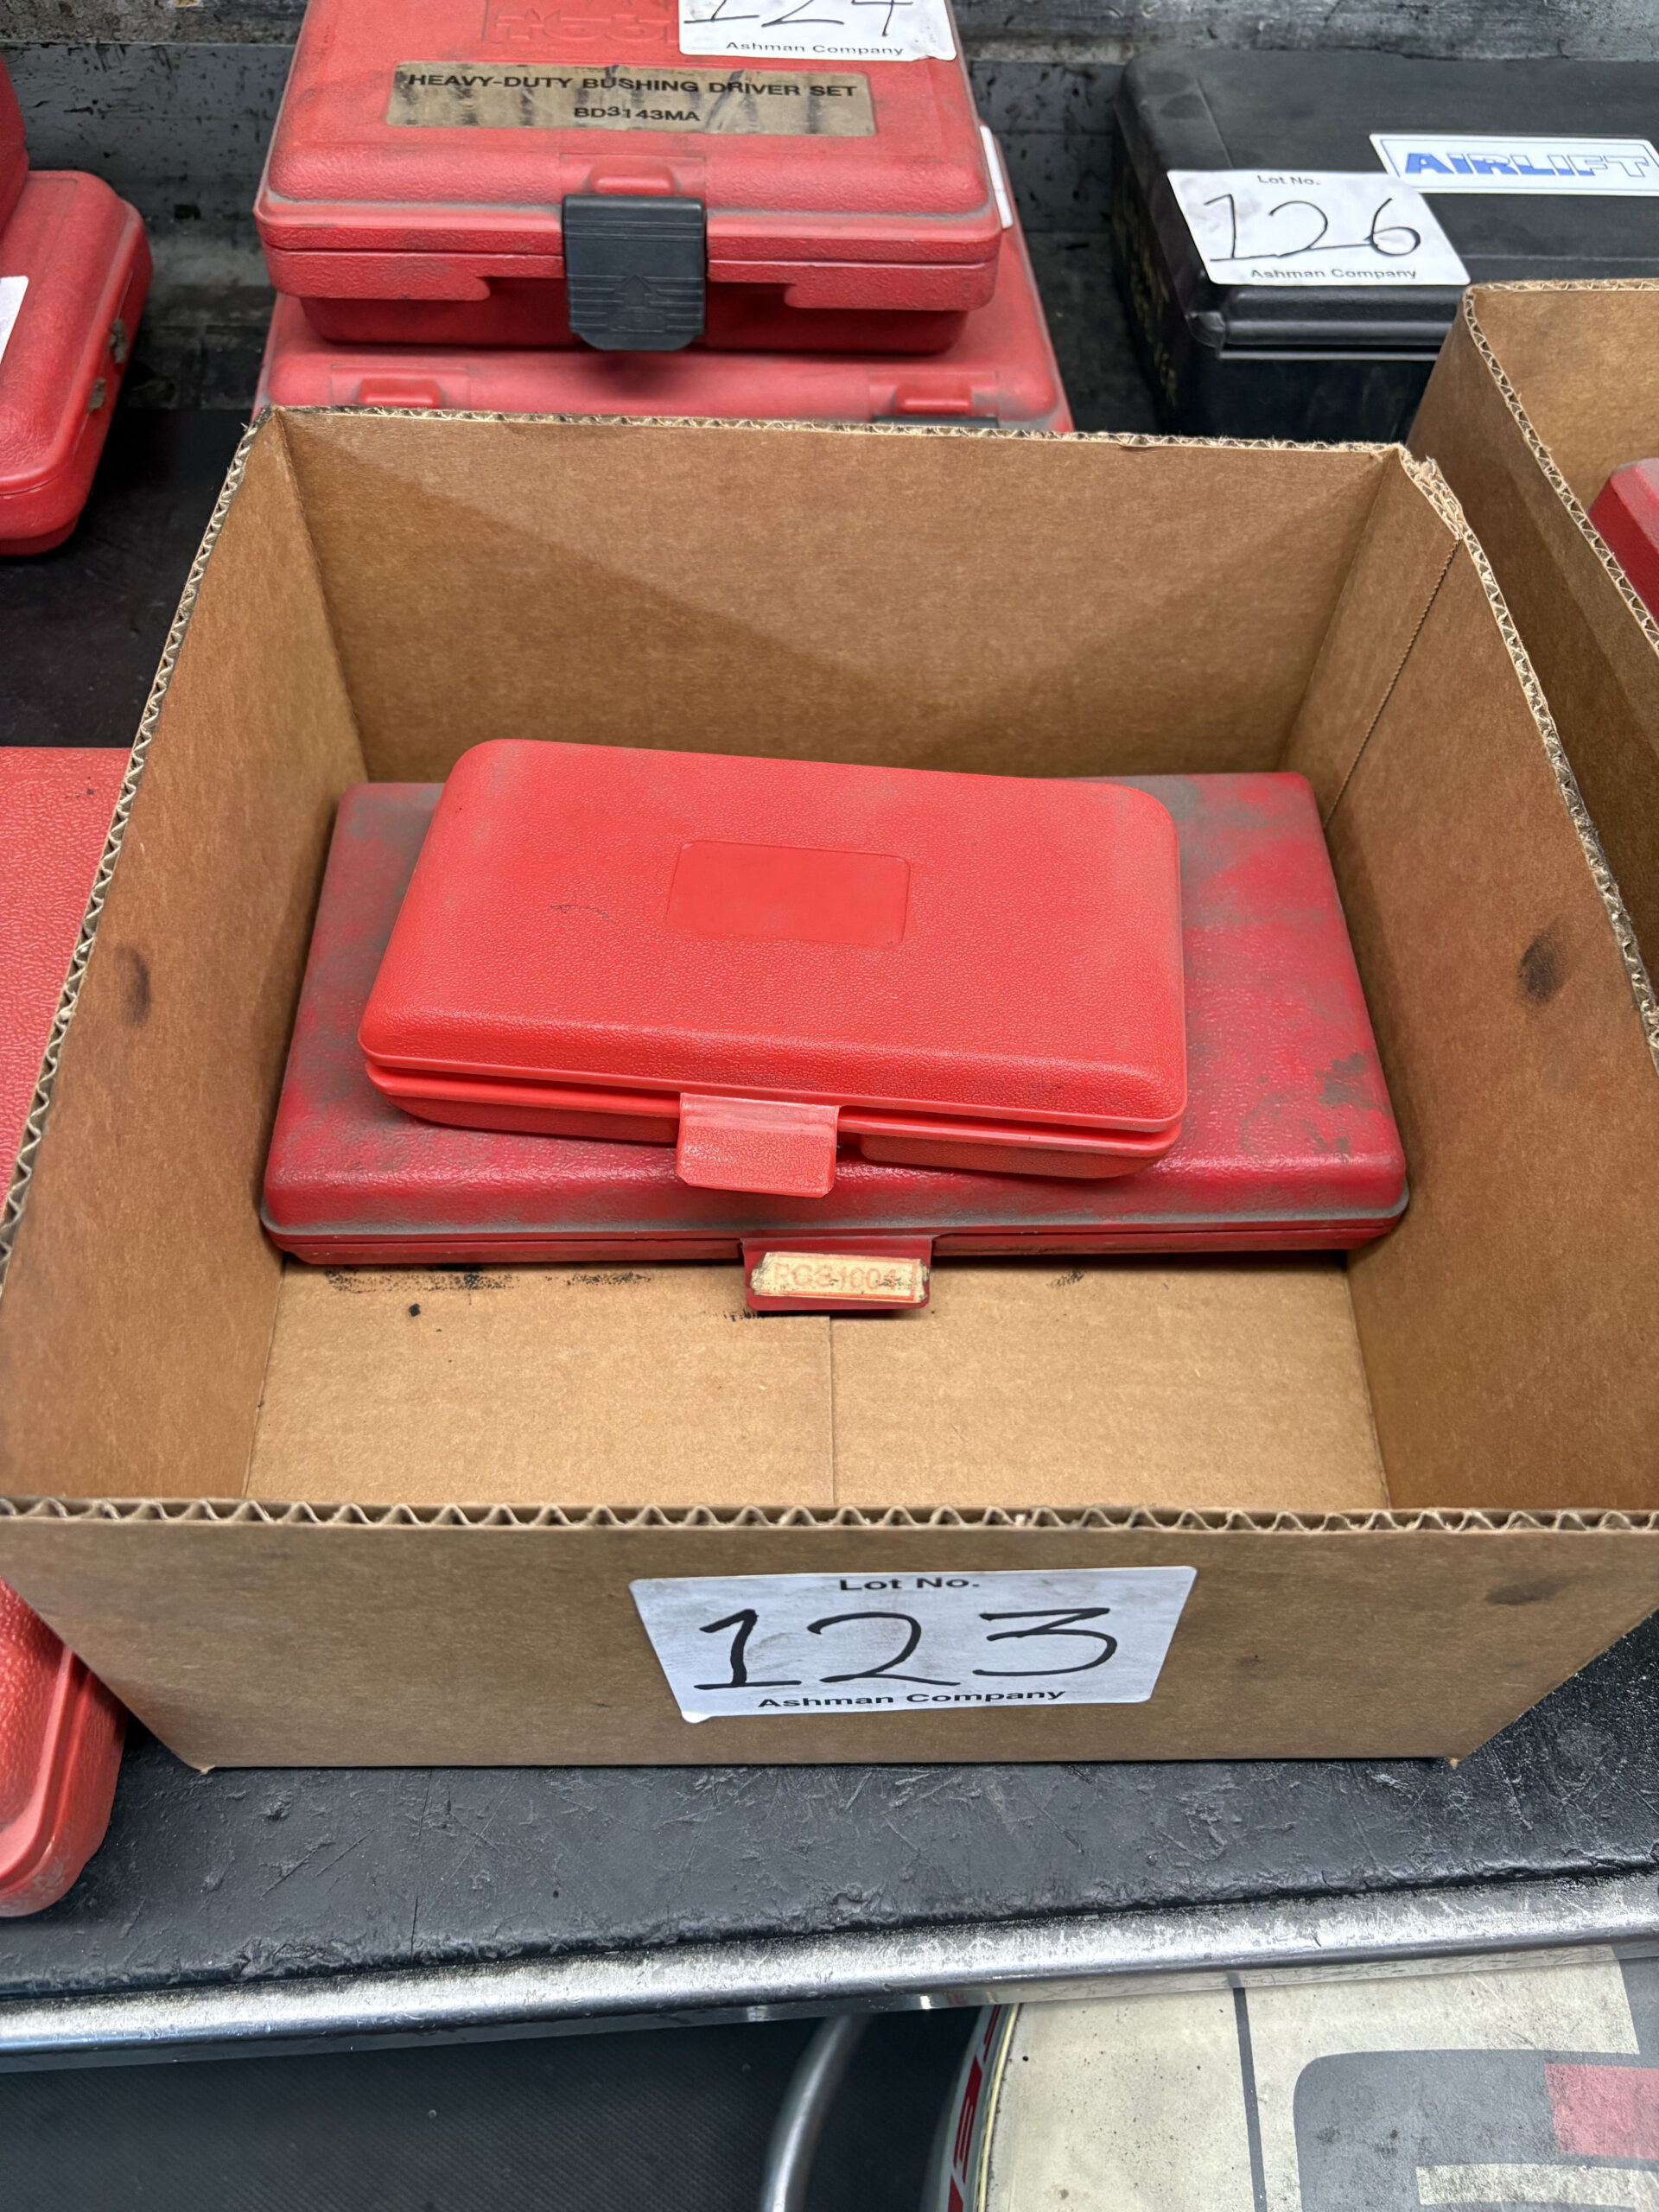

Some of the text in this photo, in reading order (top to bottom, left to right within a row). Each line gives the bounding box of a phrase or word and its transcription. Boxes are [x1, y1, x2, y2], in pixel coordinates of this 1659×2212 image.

[726, 42, 904, 56] Ashman Company
[409, 74, 858, 98] HEAVY-DUTY BUSHING DRIVER SET
[574, 106, 702, 122] BD3143MA
[1405, 152, 1650, 178] AIRLIFT
[1256, 175, 1321, 187] Lot No.
[1203, 194, 1421, 263] 126
[1250, 269, 1417, 281] Ashman Company
[839, 1576, 982, 1592] Lot No.
[694, 1607, 1118, 1690] 123
[757, 1688, 1067, 1709] Ashman Company
